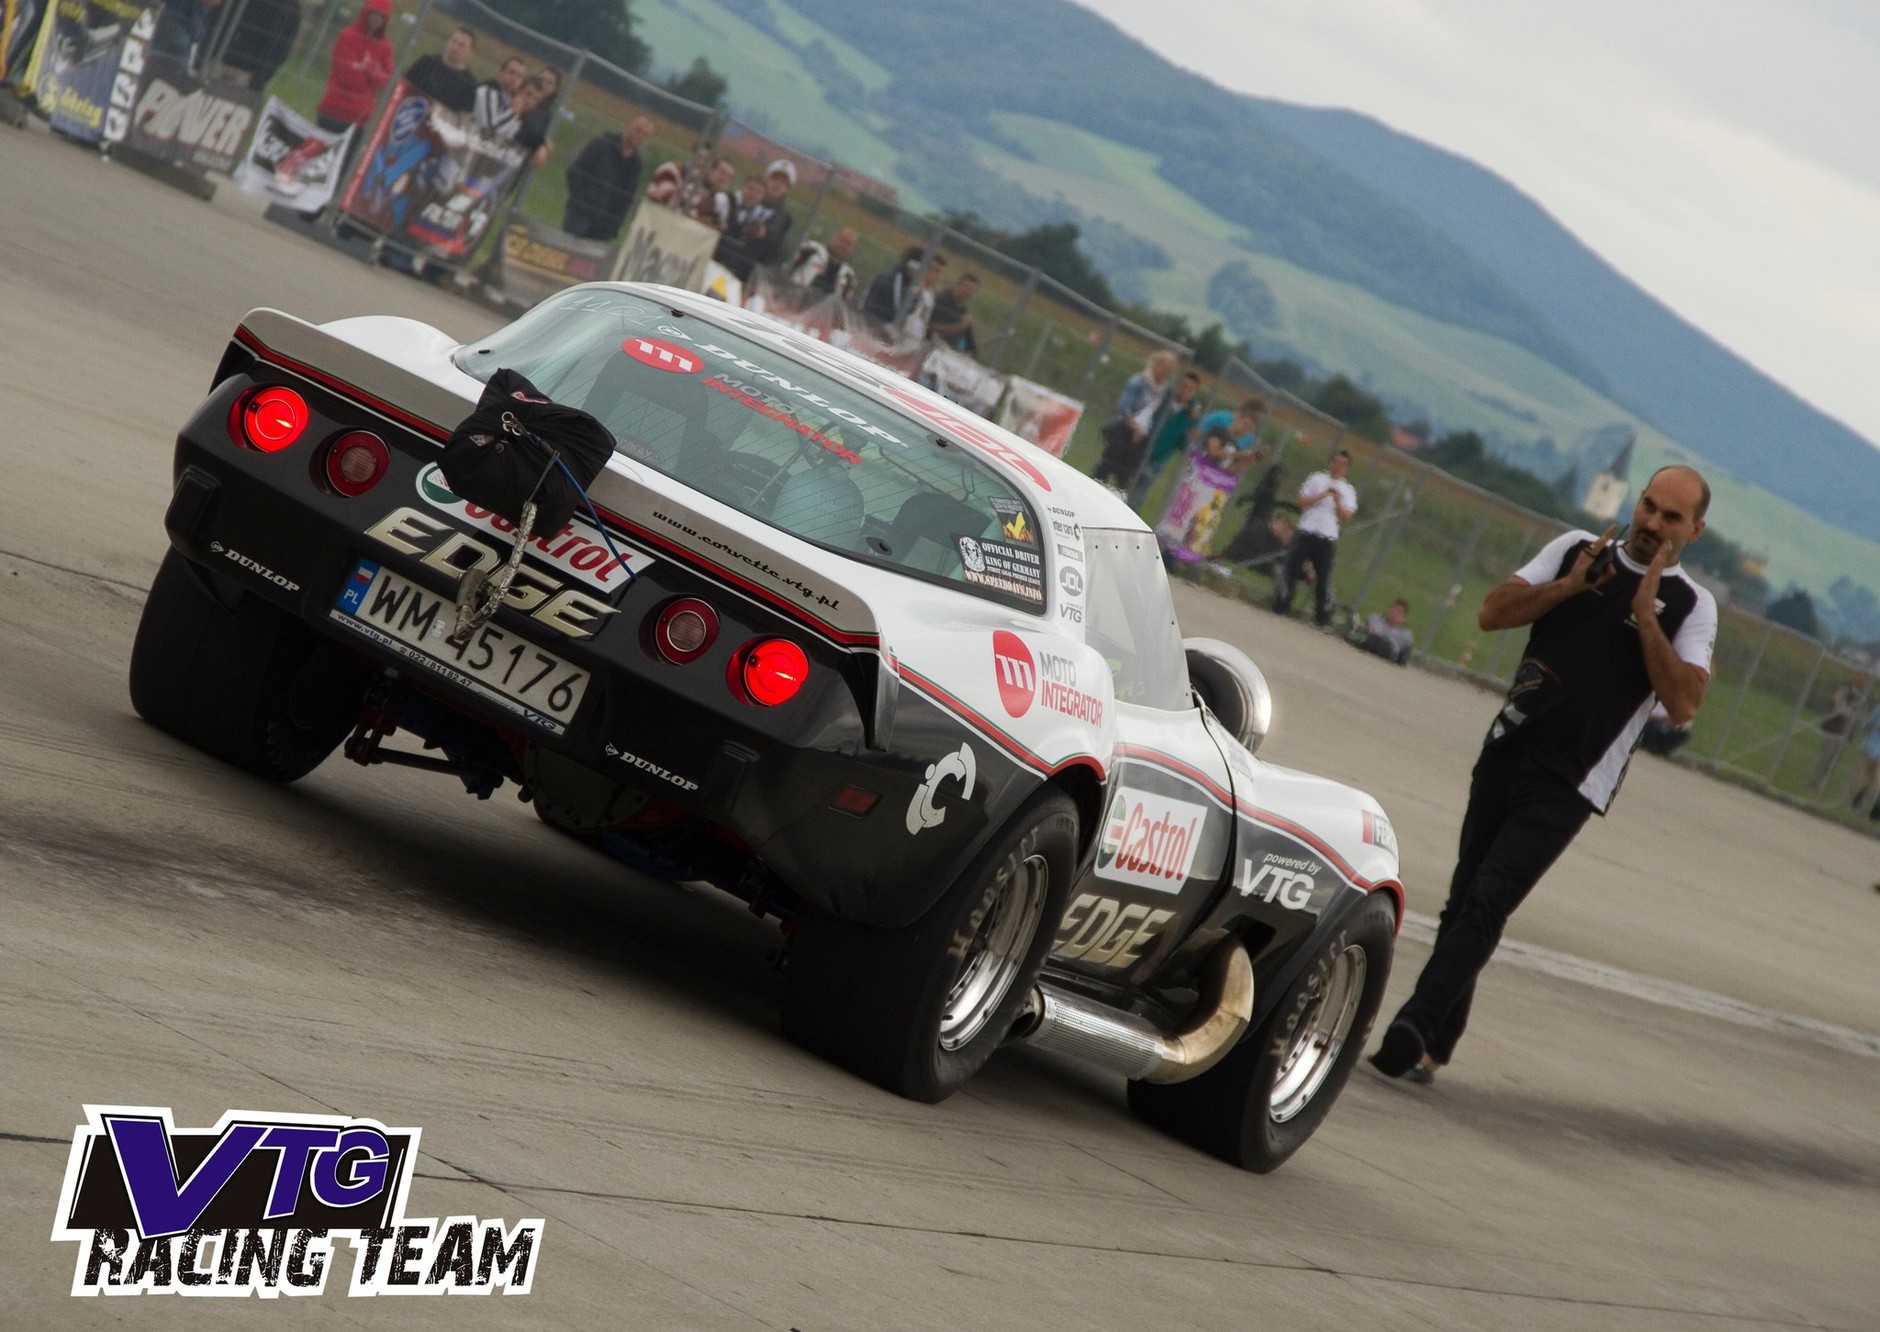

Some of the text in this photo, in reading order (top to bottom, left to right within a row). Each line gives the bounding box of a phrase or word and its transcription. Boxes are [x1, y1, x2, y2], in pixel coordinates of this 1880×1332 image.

[134, 79, 252, 155] POWER
[694, 343, 909, 448] DUNLOP
[715, 372, 798, 417] MOTO
[701, 377, 864, 464] INTEGRATOR
[464, 501, 633, 584] trol
[652, 511, 838, 610] www.corvette.vtg.pl
[982, 542, 1014, 558] OFFICIAL
[1014, 549, 1040, 566] DRIVER
[224, 548, 300, 593] DUNLOP
[363, 506, 622, 638] EDGE
[985, 555, 1002, 568] KING
[1003, 559, 1011, 570] OF
[1012, 562, 1040, 579] GERMANY
[343, 588, 359, 606] PL
[1060, 603, 1083, 624] VTG
[337, 613, 393, 646] www.vtg.pl
[369, 575, 583, 713] WM 45176
[1039, 651, 1077, 688] MOTO
[523, 707, 556, 730] VTG
[1041, 679, 1104, 729] INTEGRATOR
[619, 750, 699, 792] DUNLOP
[1115, 802, 1198, 881] Castrol
[1263, 853, 1322, 876] powered by
[1240, 858, 1315, 910] VTG
[1047, 893, 1178, 968] EDGE
